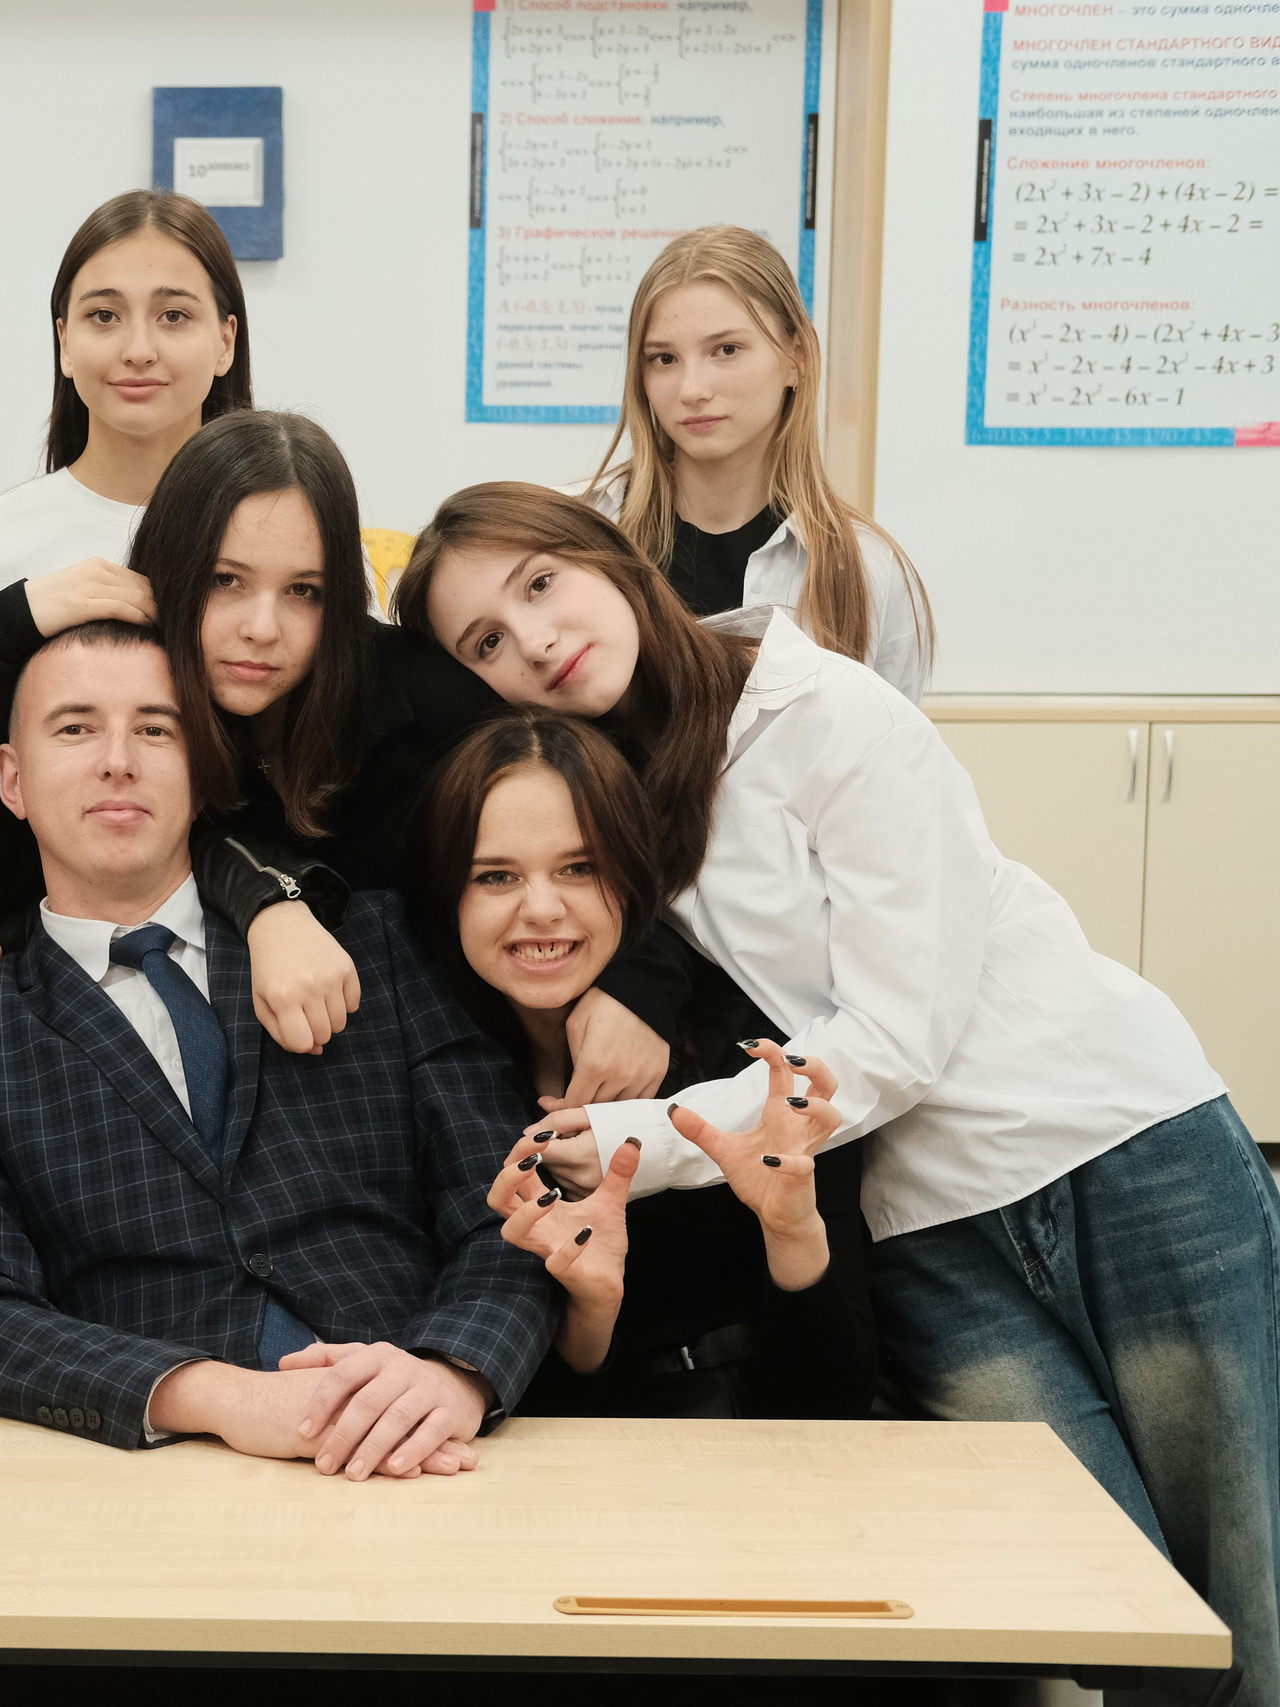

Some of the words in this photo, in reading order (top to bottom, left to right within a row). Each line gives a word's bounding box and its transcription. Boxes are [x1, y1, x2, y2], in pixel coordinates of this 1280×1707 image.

[1014, 5, 1114, 16] МНОГОЧЛЕН
[1131, 6, 1156, 16] это
[1161, 5, 1209, 18] сумма
[1012, 39, 1112, 51] МНОГОЧЛЕН
[1116, 37, 1245, 51] СТАНДАРТНОГО
[1011, 61, 1060, 71] сумма
[1064, 59, 1157, 70] одночленов
[1161, 57, 1267, 69] стандартного
[1010, 90, 1073, 101] Степень
[1078, 90, 1168, 101] многочлена
[1173, 90, 1278, 101] стандартного
[1006, 157, 1090, 169] Сложение
[1095, 158, 1211, 170] многочленов:
[1000, 298, 1076, 311] Разность
[1081, 300, 1195, 311] многочленов:
